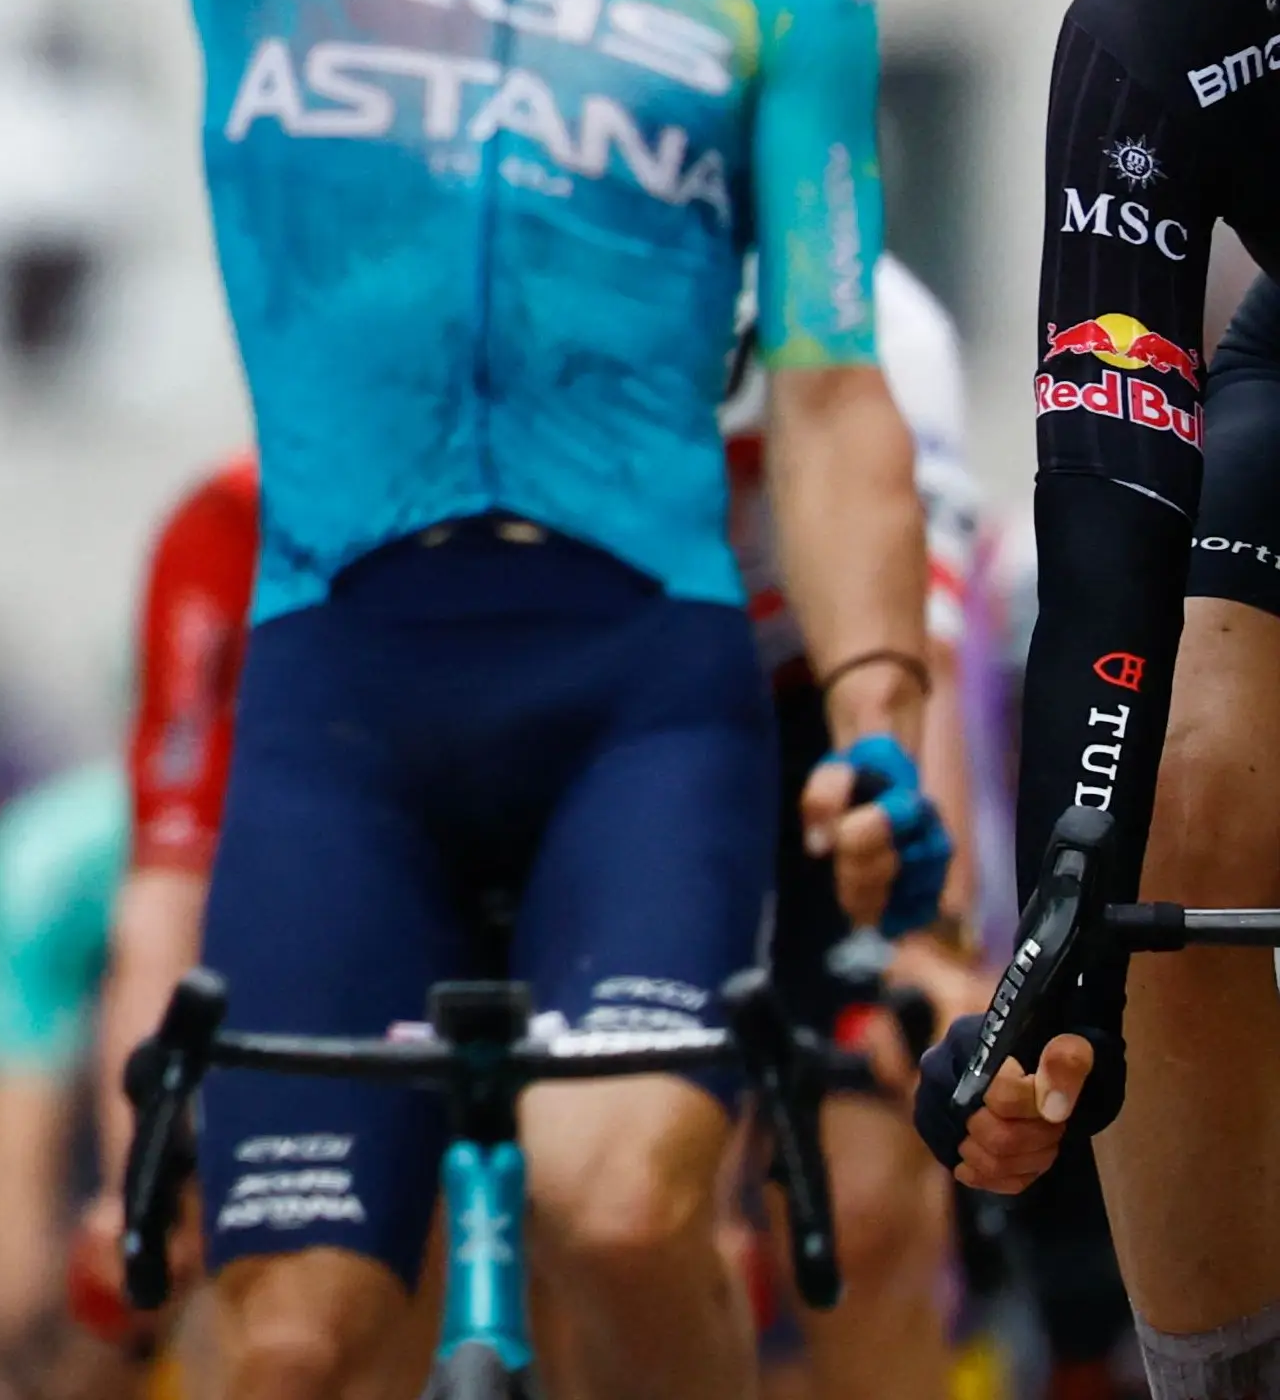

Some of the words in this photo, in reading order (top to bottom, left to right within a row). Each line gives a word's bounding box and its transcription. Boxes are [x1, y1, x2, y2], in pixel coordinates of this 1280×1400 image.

[224, 38, 732, 226] ASTANA
[1060, 188, 1188, 261] MSC
[1035, 369, 1124, 419] Red
[1127, 377, 1204, 452] Bul
[1074, 704, 1130, 812] TUD
[969, 938, 1042, 1077] SRAM
